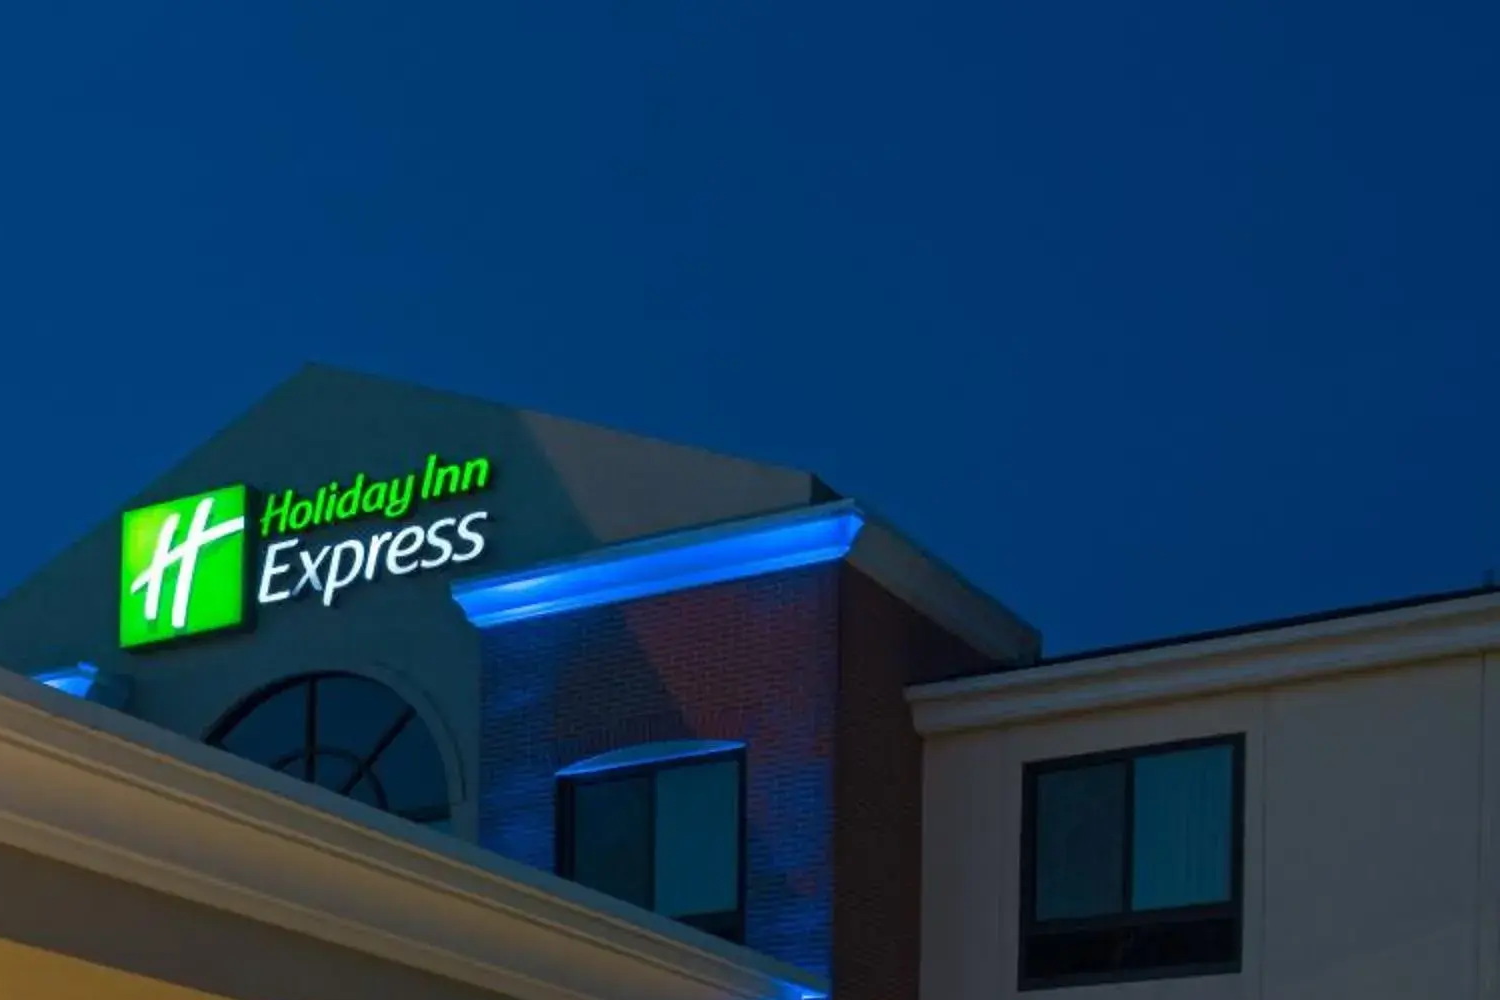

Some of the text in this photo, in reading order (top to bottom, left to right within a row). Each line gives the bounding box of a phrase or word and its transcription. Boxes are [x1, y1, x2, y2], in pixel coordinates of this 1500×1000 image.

[260, 453, 490, 537] Holiday Inn
[257, 511, 488, 607] Express
